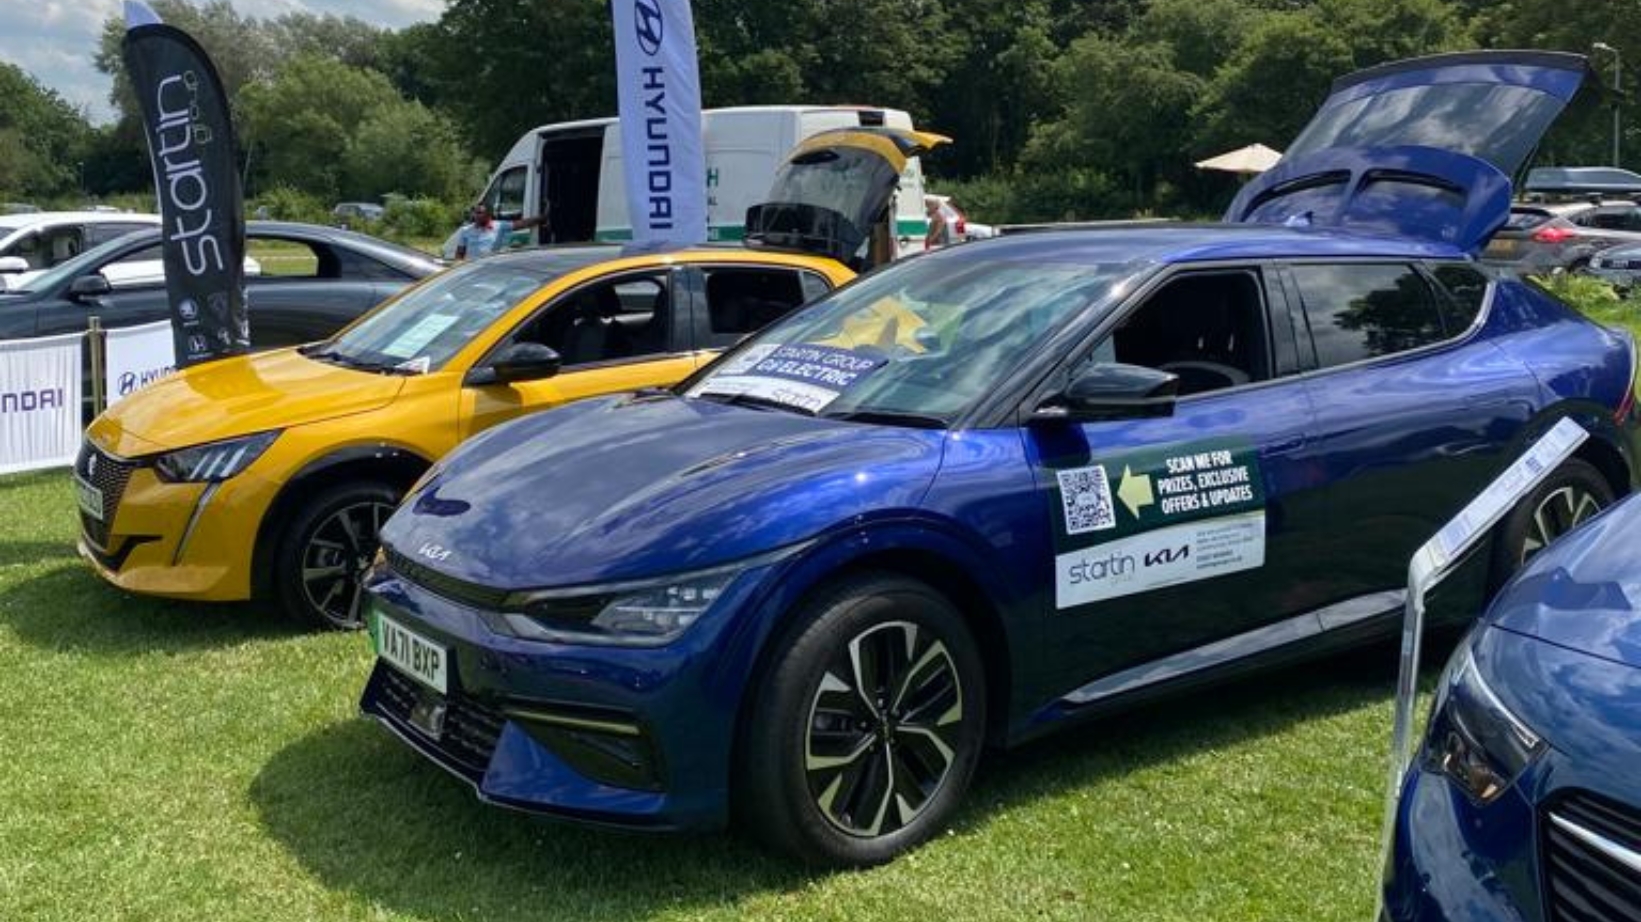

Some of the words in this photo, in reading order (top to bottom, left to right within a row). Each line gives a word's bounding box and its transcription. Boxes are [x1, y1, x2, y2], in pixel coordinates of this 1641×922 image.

[642, 67, 674, 229] HYUNDAI
[156, 74, 224, 275] startin
[1, 388, 63, 413] NDAI
[1166, 455, 1195, 474] SCAN
[1194, 452, 1212, 469] ME
[1210, 450, 1233, 467] FOR
[1198, 466, 1250, 489] EXCLUSIVE
[1162, 493, 1200, 514] OFFERS
[1209, 485, 1254, 506] UPDATES
[1068, 552, 1136, 585] startin
[1144, 544, 1190, 567] KIA
[382, 618, 411, 666] VA71
[412, 638, 441, 681] BXP
